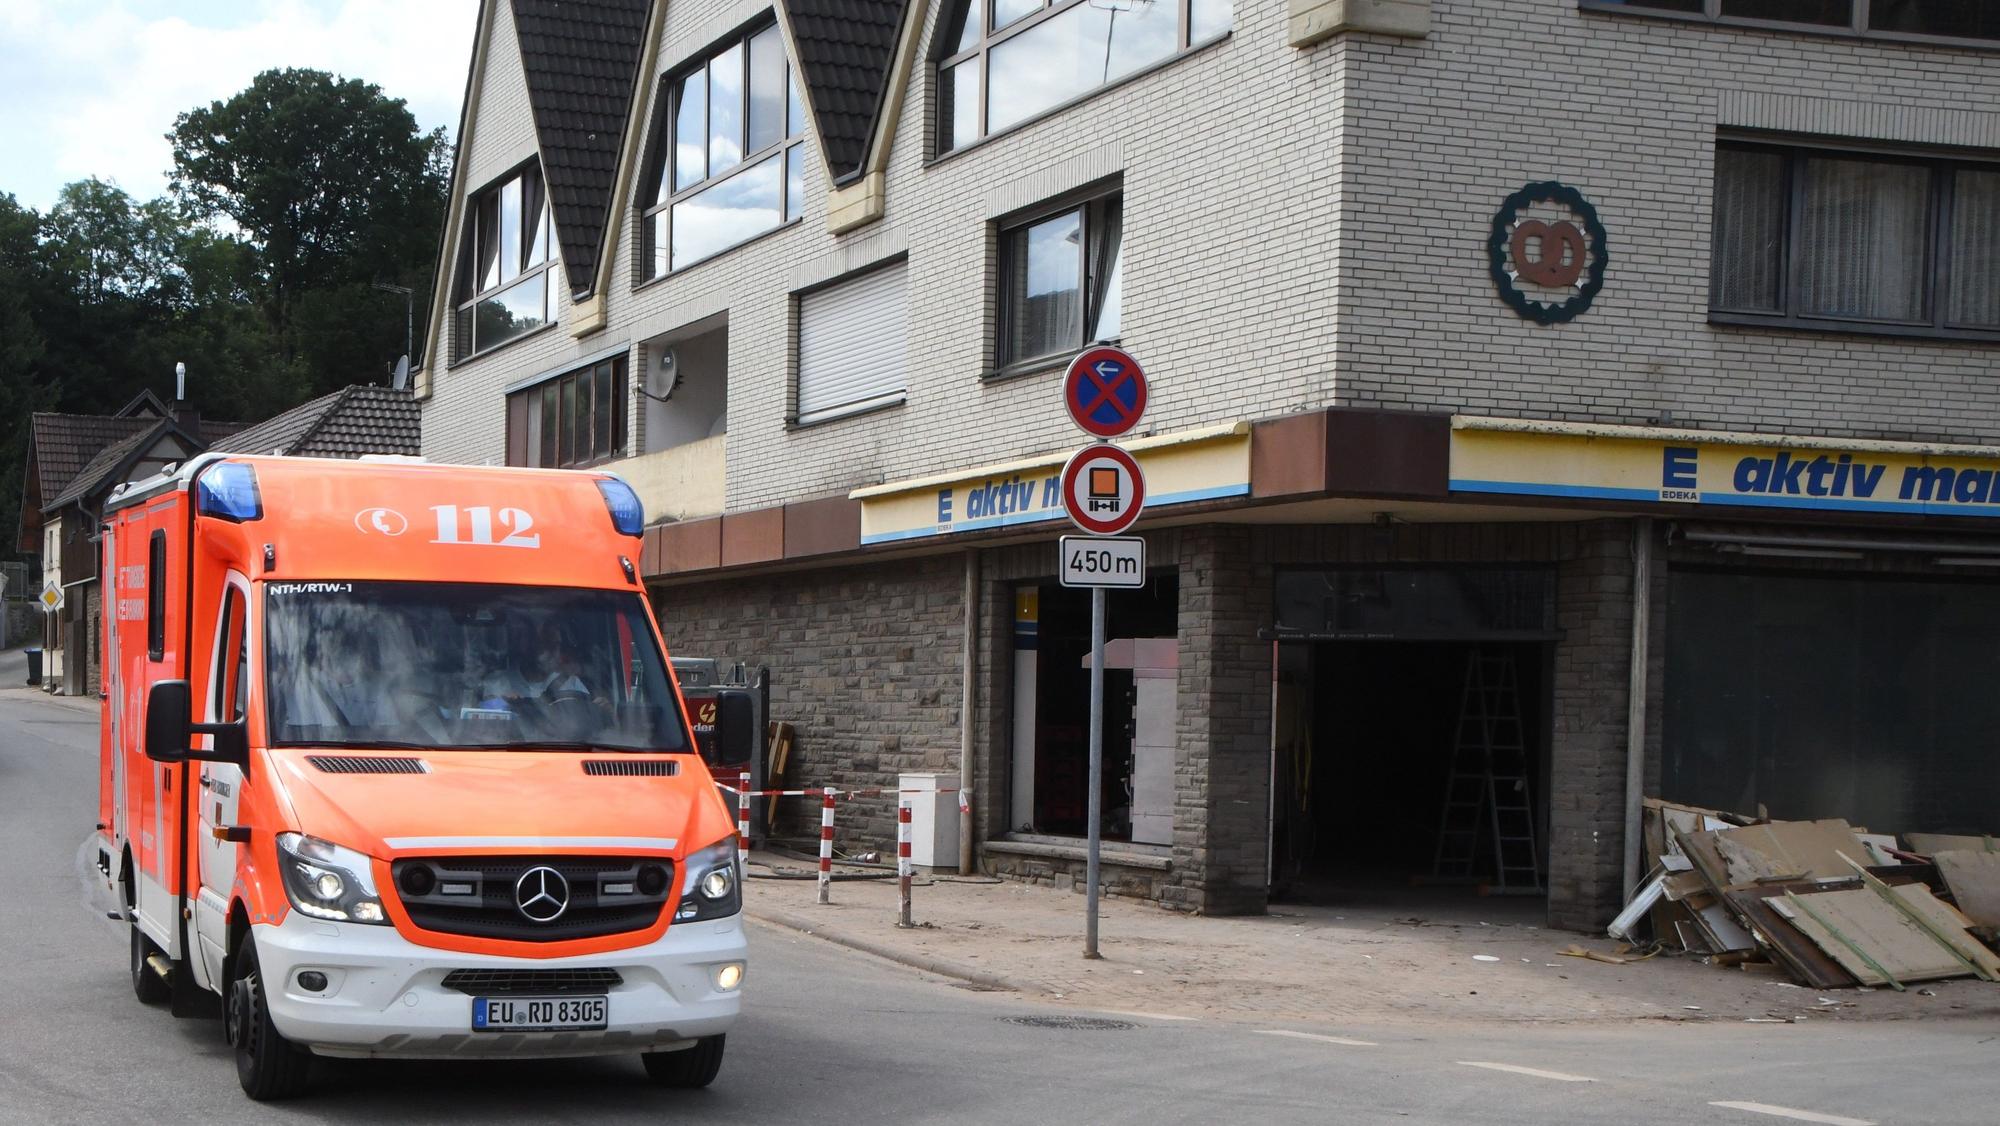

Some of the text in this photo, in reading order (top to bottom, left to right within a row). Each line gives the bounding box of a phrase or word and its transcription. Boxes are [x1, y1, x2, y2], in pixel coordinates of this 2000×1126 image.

[1733, 452, 1887, 498] aktiv
[967, 475, 1036, 519] aktiv
[1662, 491, 1697, 500] EDEKA
[429, 505, 540, 548] 112
[1070, 550, 1137, 573] 450 m
[270, 583, 353, 595] NTH/RTW-1
[488, 1001, 603, 1023] EU RD 8305
